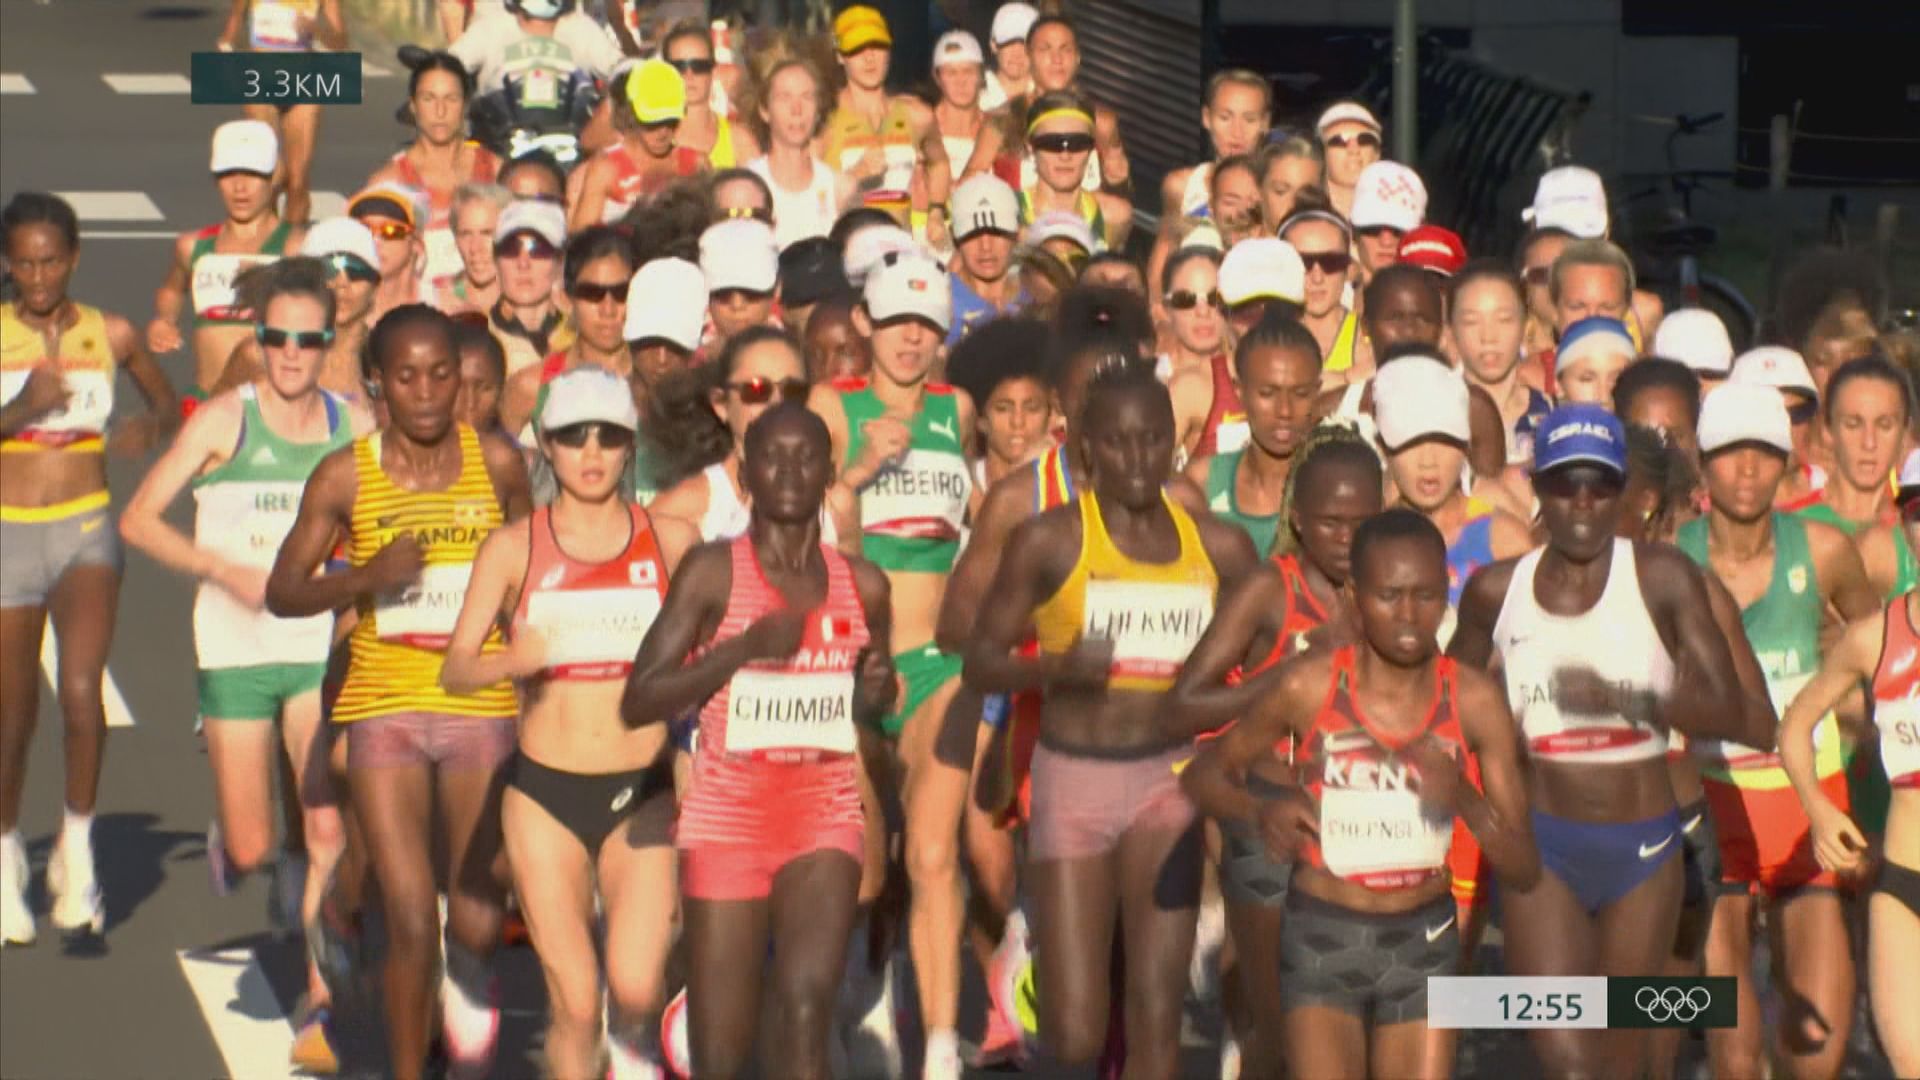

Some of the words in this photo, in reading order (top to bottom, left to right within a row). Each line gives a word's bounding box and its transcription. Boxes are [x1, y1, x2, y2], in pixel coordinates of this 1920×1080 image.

[1547, 422, 1614, 444] ISRAEL
[875, 469, 965, 499] RIBEIRO
[255, 493, 289, 511] IRE
[380, 527, 479, 545] UANDA
[795, 648, 850, 669] RAIN
[736, 693, 845, 722] CHUMBA
